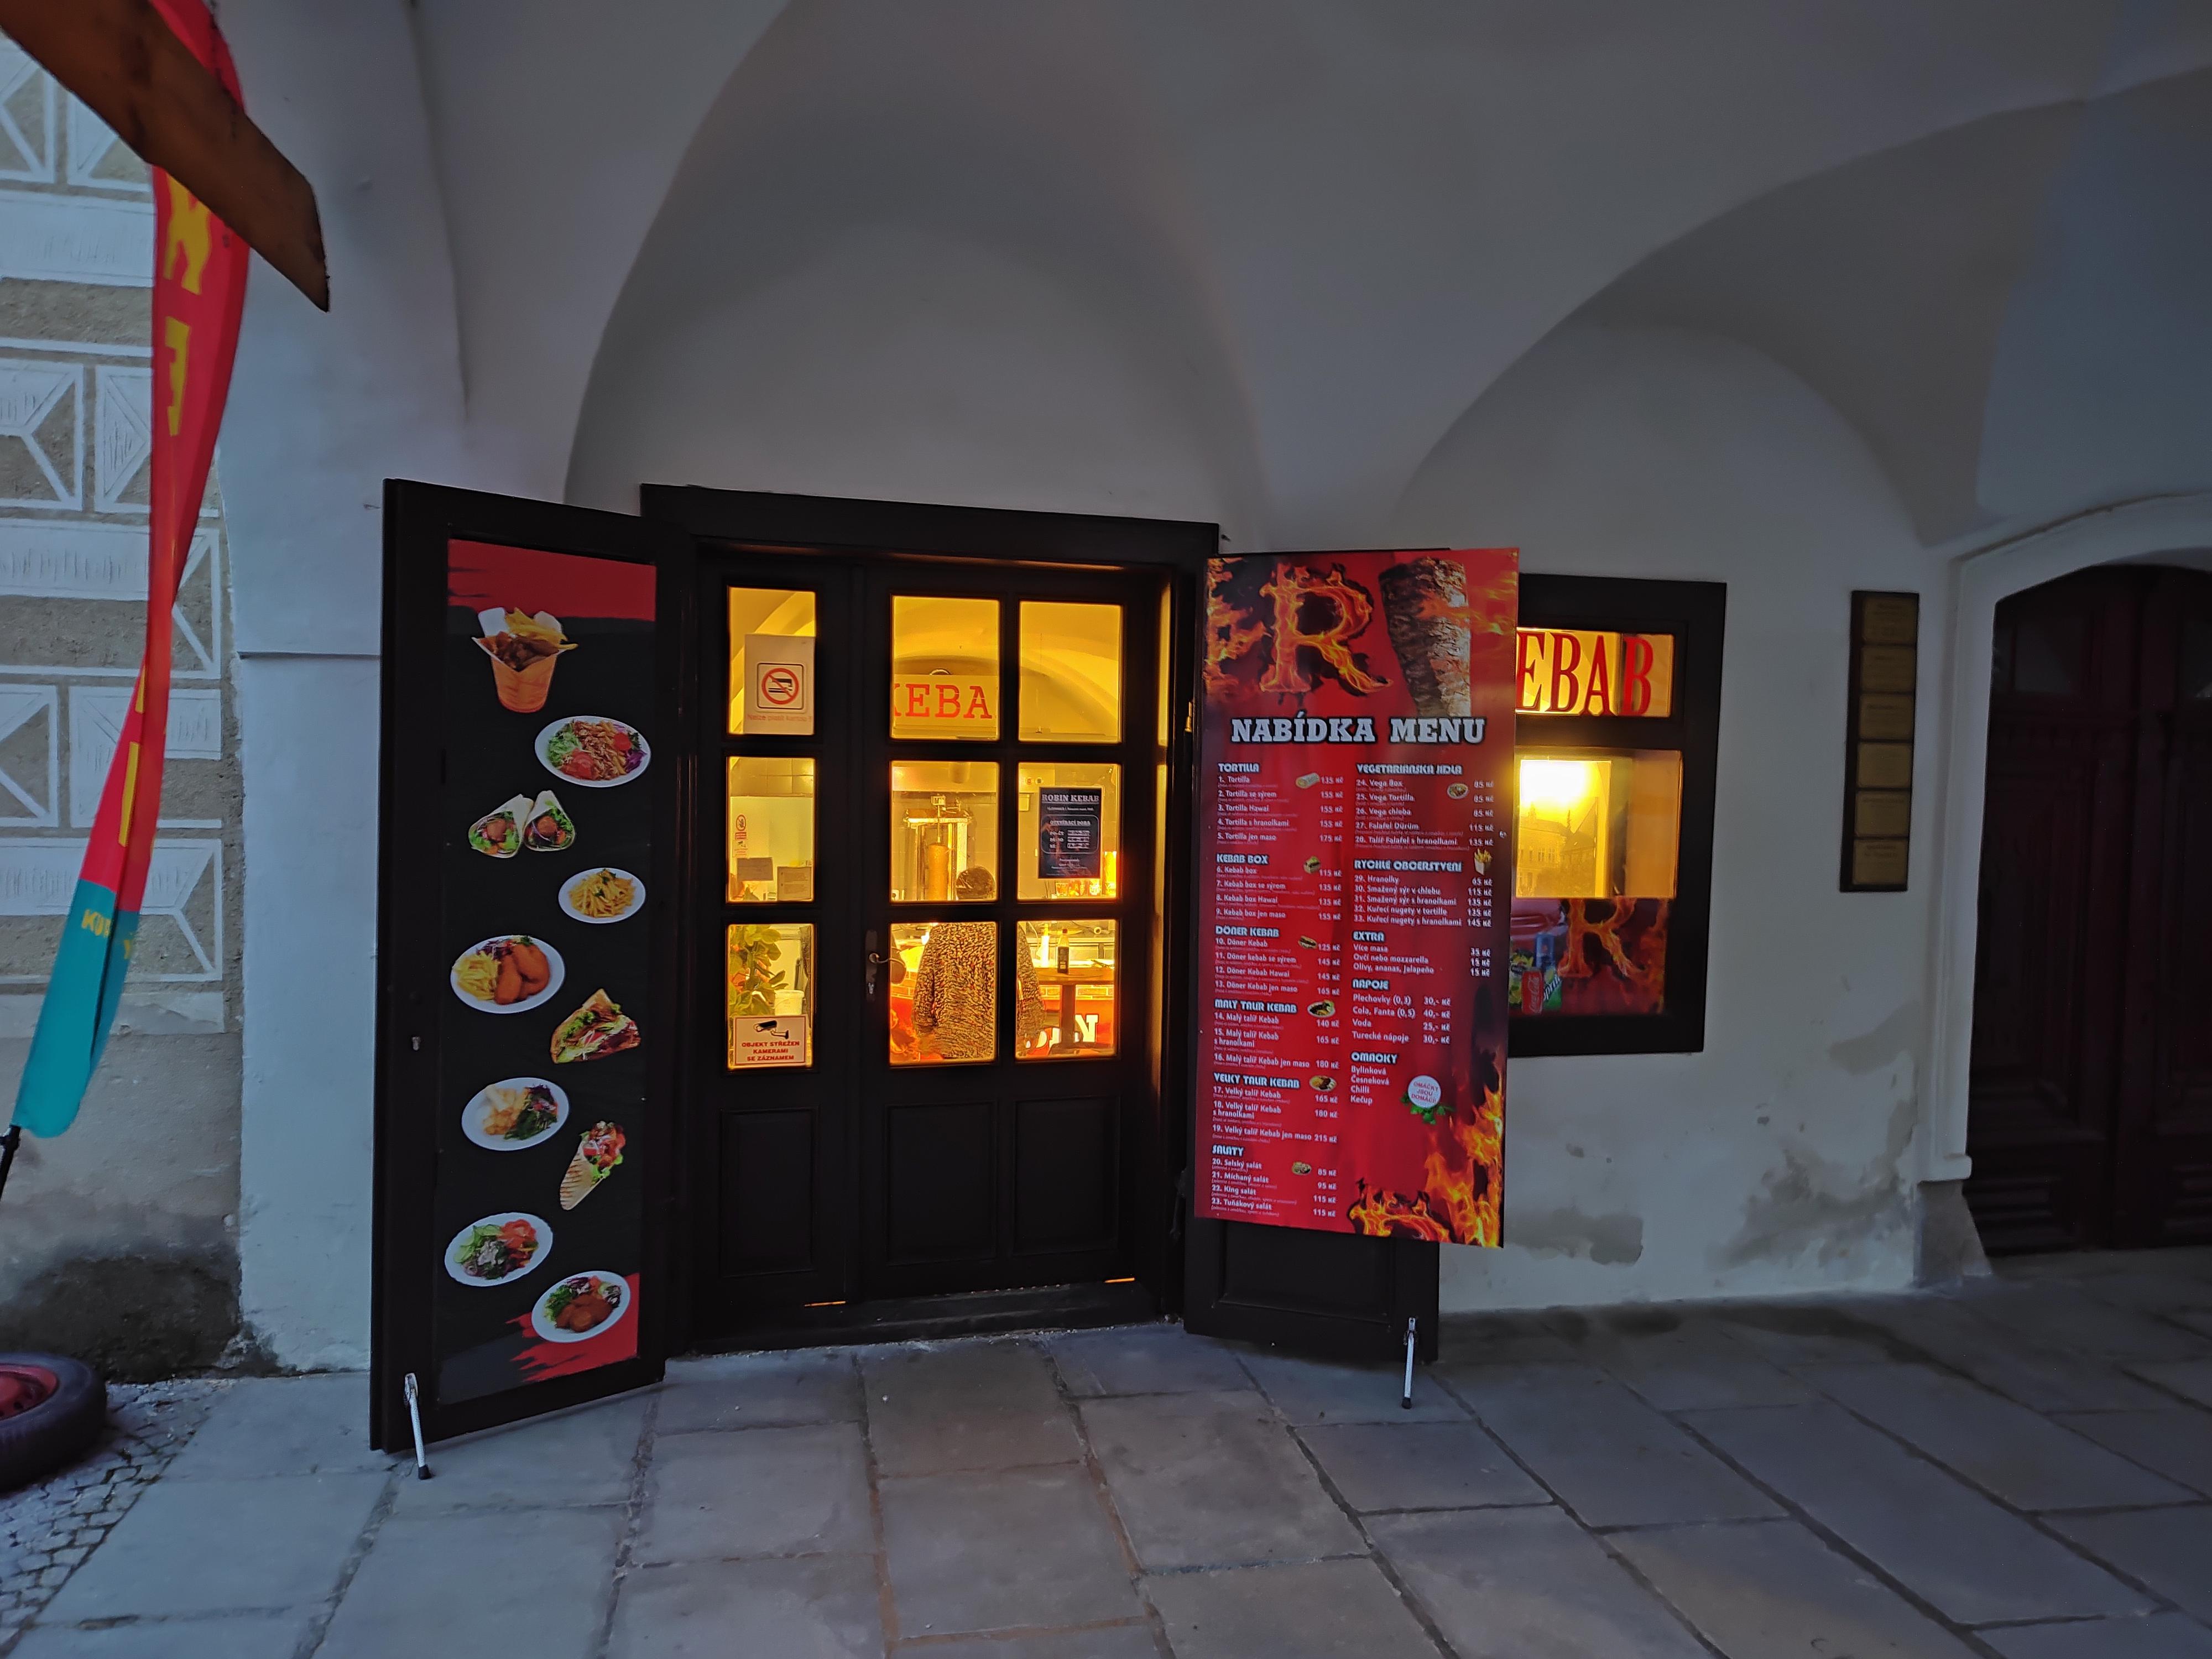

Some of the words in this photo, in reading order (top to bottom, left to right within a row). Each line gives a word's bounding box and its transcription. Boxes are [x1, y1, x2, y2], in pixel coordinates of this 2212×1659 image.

[1259, 562, 1394, 696] R
[1232, 709, 1376, 744] NABÍDKA
[1390, 718, 1484, 743] MENU
[1218, 763, 1259, 773] TORTILLA
[1217, 854, 1246, 863] KEBAB
[1248, 855, 1269, 864] BOX
[1368, 875, 1399, 884] Hranolky
[1215, 926, 1247, 936] DÖNER
[1250, 928, 1279, 937] KEBAB
[1353, 931, 1384, 941] EXTRA
[1277, 956, 1296, 965] sýrem
[1269, 984, 1279, 992] jen
[1353, 979, 1389, 989] NAPOJE
[1353, 994, 1390, 1005] Plechovky
[1267, 1003, 1297, 1013] KEBAB
[1353, 1006, 1371, 1015] Cola,
[1374, 1008, 1394, 1017] Fanta
[1352, 1019, 1371, 1027] Voda
[1352, 1031, 1381, 1040] Turecké
[1384, 1032, 1409, 1044] nápoje
[1214, 1053, 1224, 1062] 16.
[1226, 1054, 1241, 1065] Malý
[1259, 1056, 1279, 1065] Kebab
[1280, 1058, 1290, 1068] jen
[1352, 1066, 1386, 1075] Bylinková
[1270, 1077, 1300, 1088] KEBAB
[1351, 1075, 1389, 1085] Česneková
[1225, 1087, 1243, 1098] Velký
[1351, 1095, 1372, 1105] Kečup
[1218, 1109, 1254, 1119] hranolkami
[1213, 1124, 1223, 1133] 19.
[1225, 1125, 1241, 1136] Velký
[1244, 1127, 1258, 1136] talíř
[1260, 1128, 1280, 1137] Kebab
[1282, 1131, 1292, 1140] jen
[1224, 1159, 1244, 1168] Selský
[1246, 1161, 1262, 1169] salát
[1224, 1172, 1251, 1182] Míchaný
[1253, 1174, 1269, 1183] salát
[1224, 1186, 1239, 1194] King
[1241, 1186, 1256, 1194] salát
[1224, 1199, 1254, 1210] Tuňákový
[1256, 1201, 1272, 1209] salát
